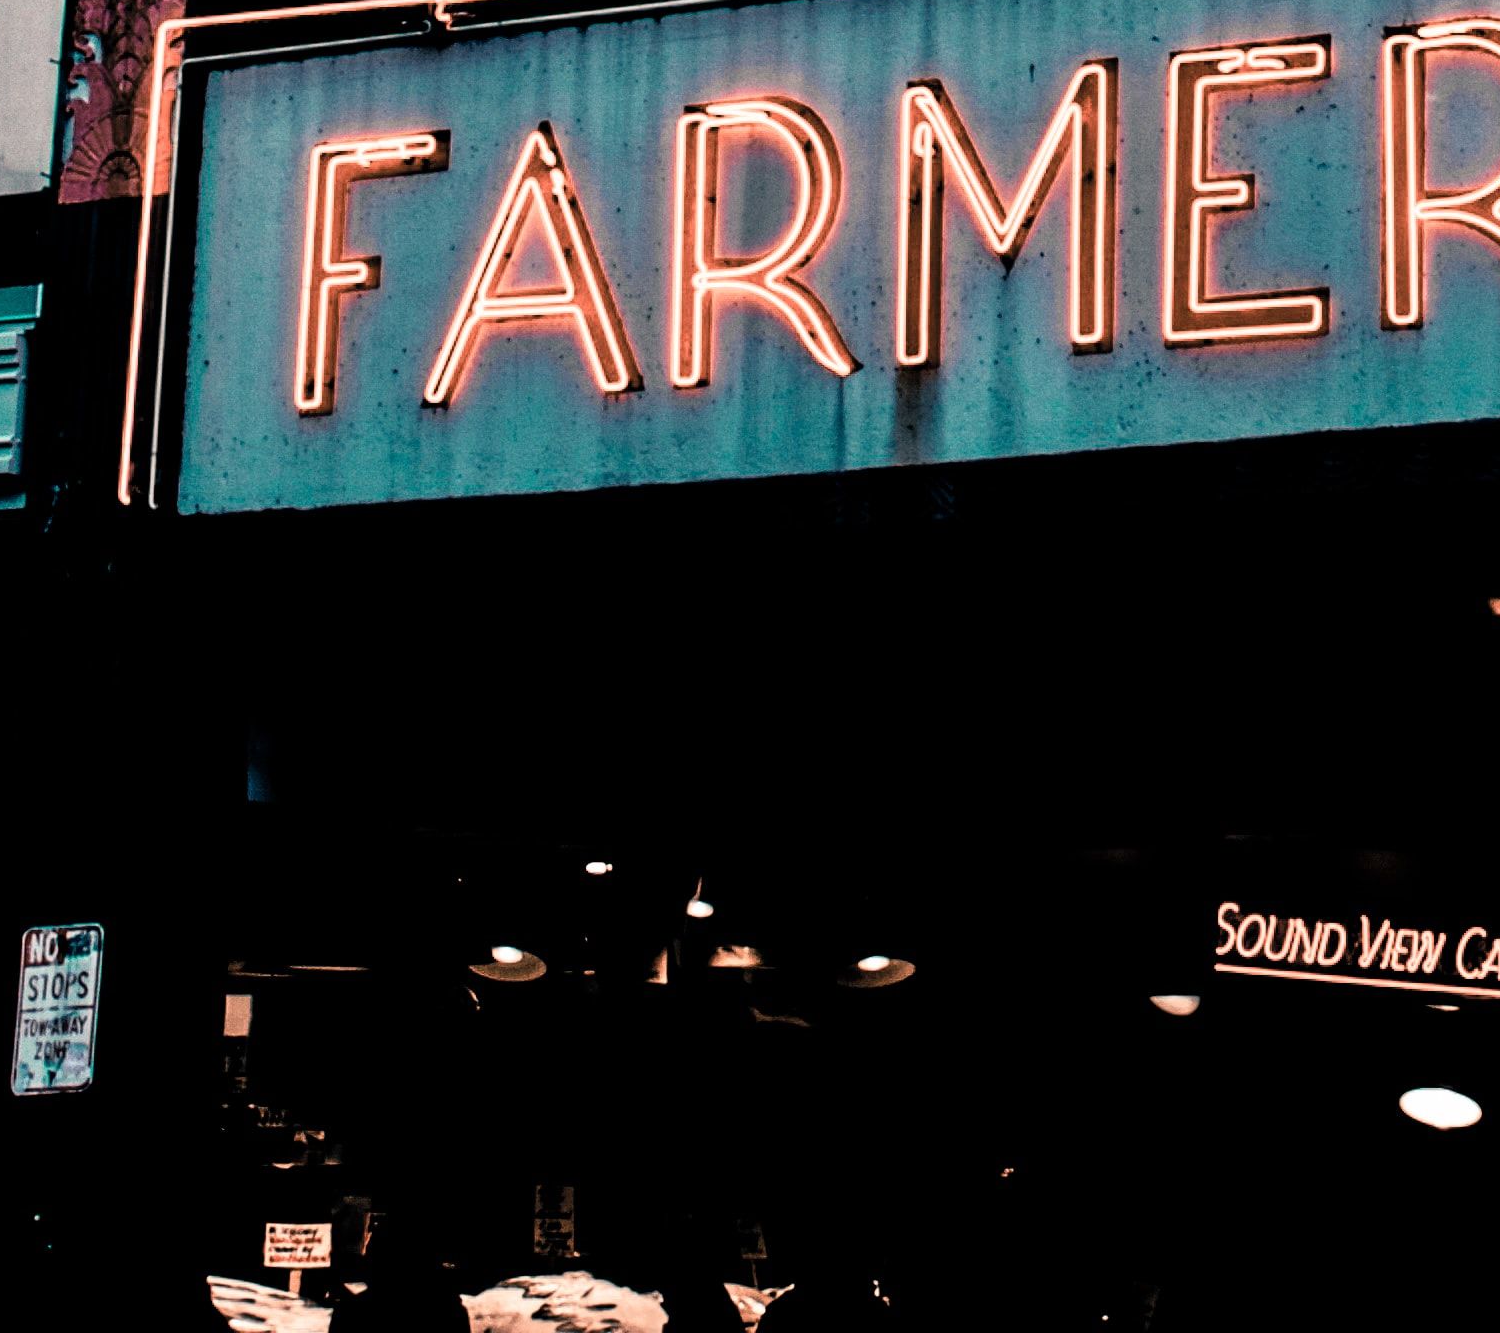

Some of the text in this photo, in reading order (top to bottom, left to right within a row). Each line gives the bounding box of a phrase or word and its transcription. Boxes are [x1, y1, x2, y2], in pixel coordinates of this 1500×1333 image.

[28, 933, 59, 964] NO
[1214, 901, 1349, 967] SOUND
[1355, 912, 1449, 976] VIEW
[28, 971, 90, 1001] STOPS
